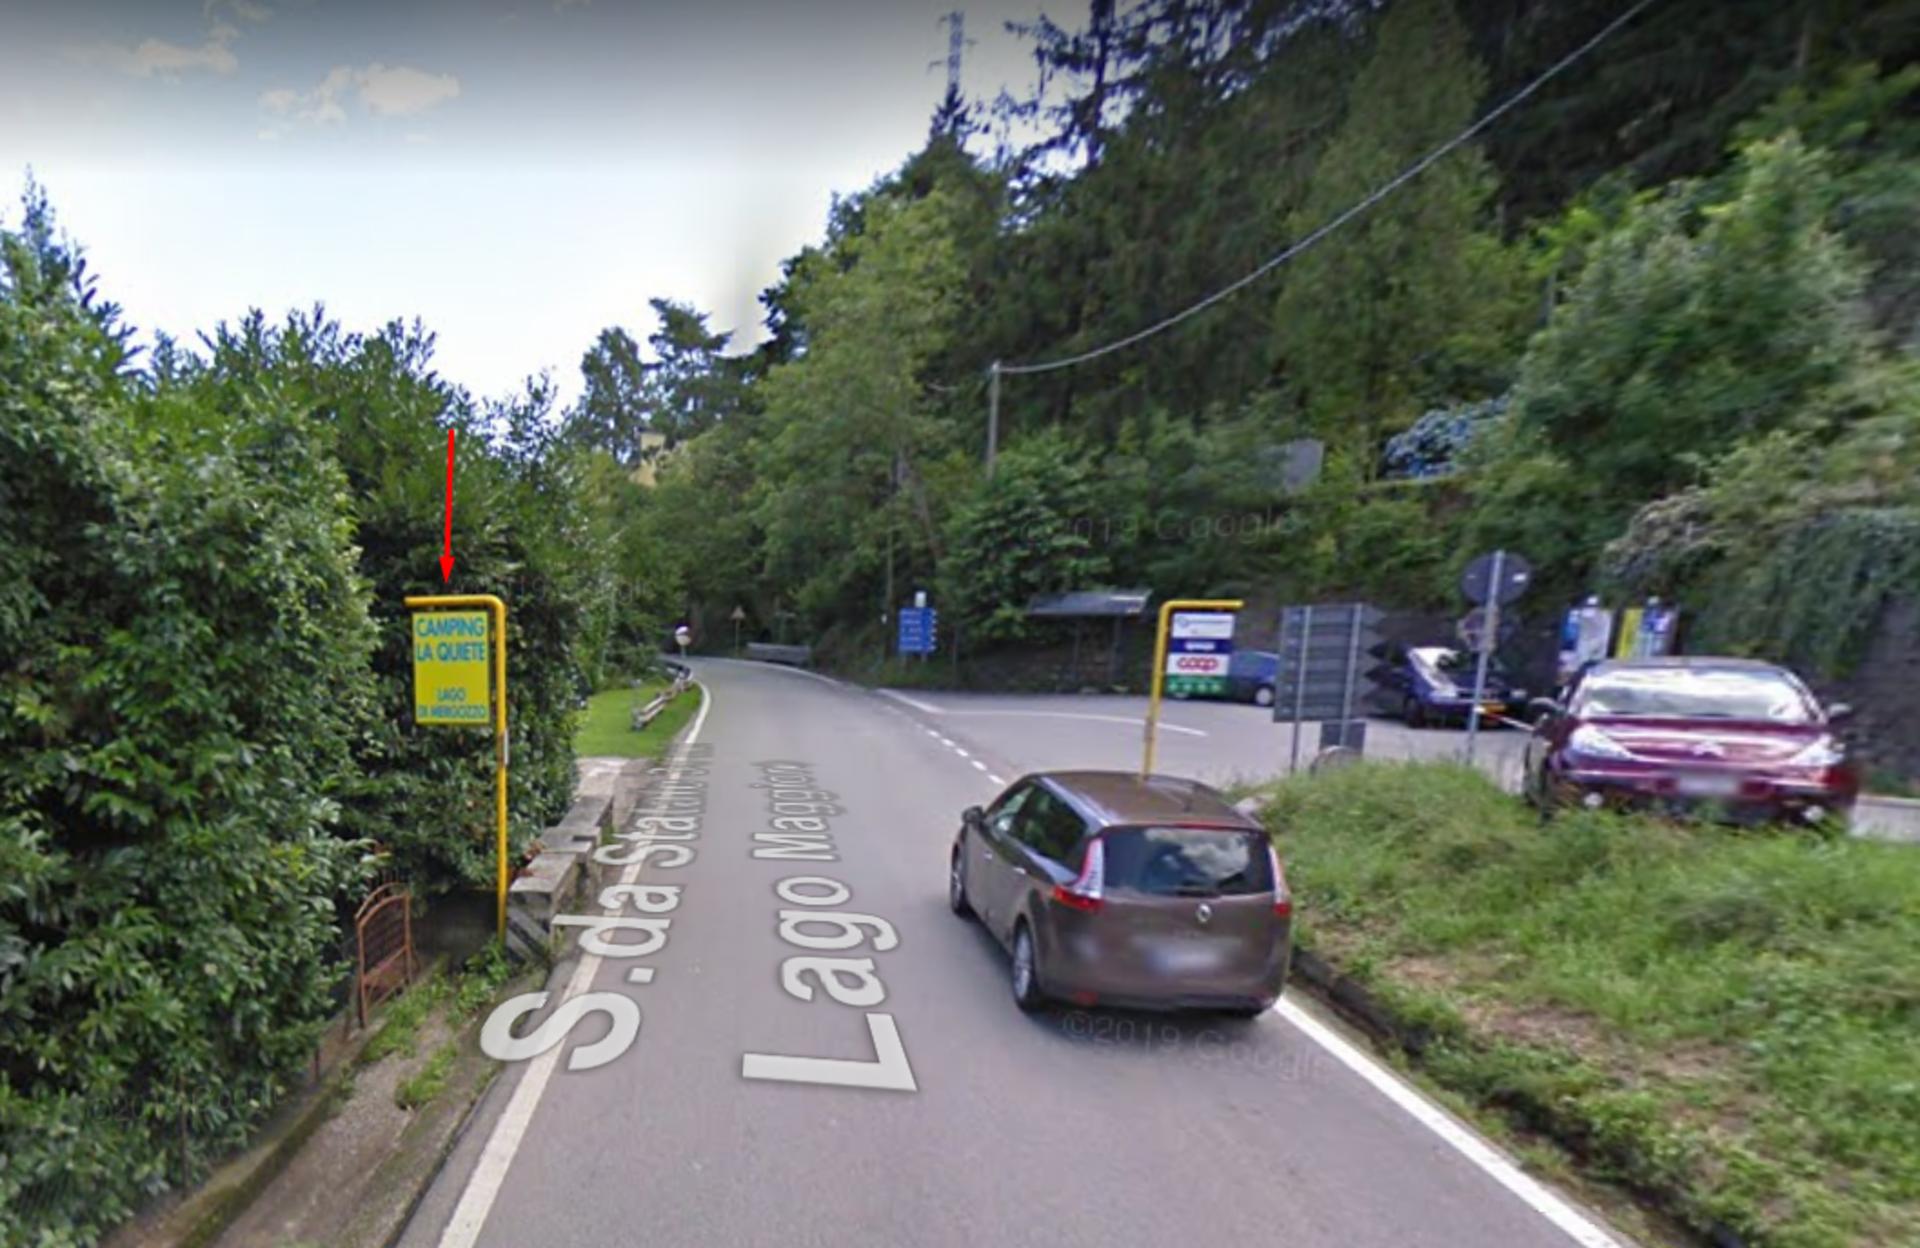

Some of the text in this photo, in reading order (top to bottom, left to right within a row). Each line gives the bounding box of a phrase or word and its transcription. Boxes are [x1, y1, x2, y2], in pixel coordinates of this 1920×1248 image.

[416, 618, 484, 637] CAMPING
[416, 642, 485, 661] LA QUIETE
[437, 688, 465, 701] LAGO
